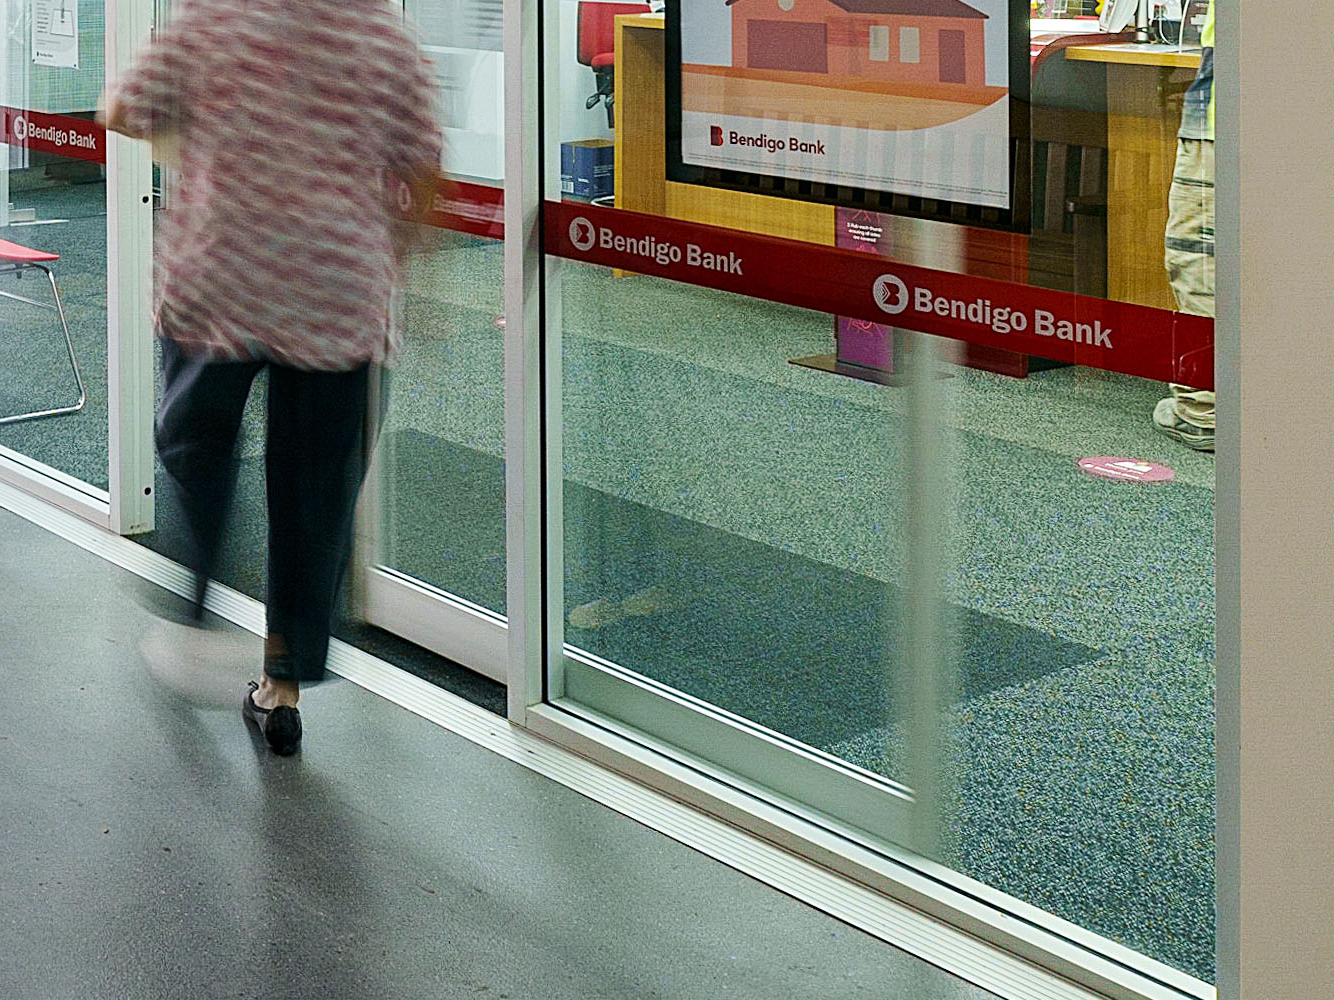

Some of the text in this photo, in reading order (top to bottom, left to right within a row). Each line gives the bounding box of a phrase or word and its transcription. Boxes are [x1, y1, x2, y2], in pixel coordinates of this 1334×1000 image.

[28, 122, 96, 150] Bendigo Bank
[729, 131, 785, 153] Bendigo
[789, 137, 826, 155] Bank
[598, 226, 682, 267] Bendigo
[685, 242, 744, 276] Bank
[913, 287, 1028, 333] Bendigo
[1033, 313, 1114, 349] Bank
